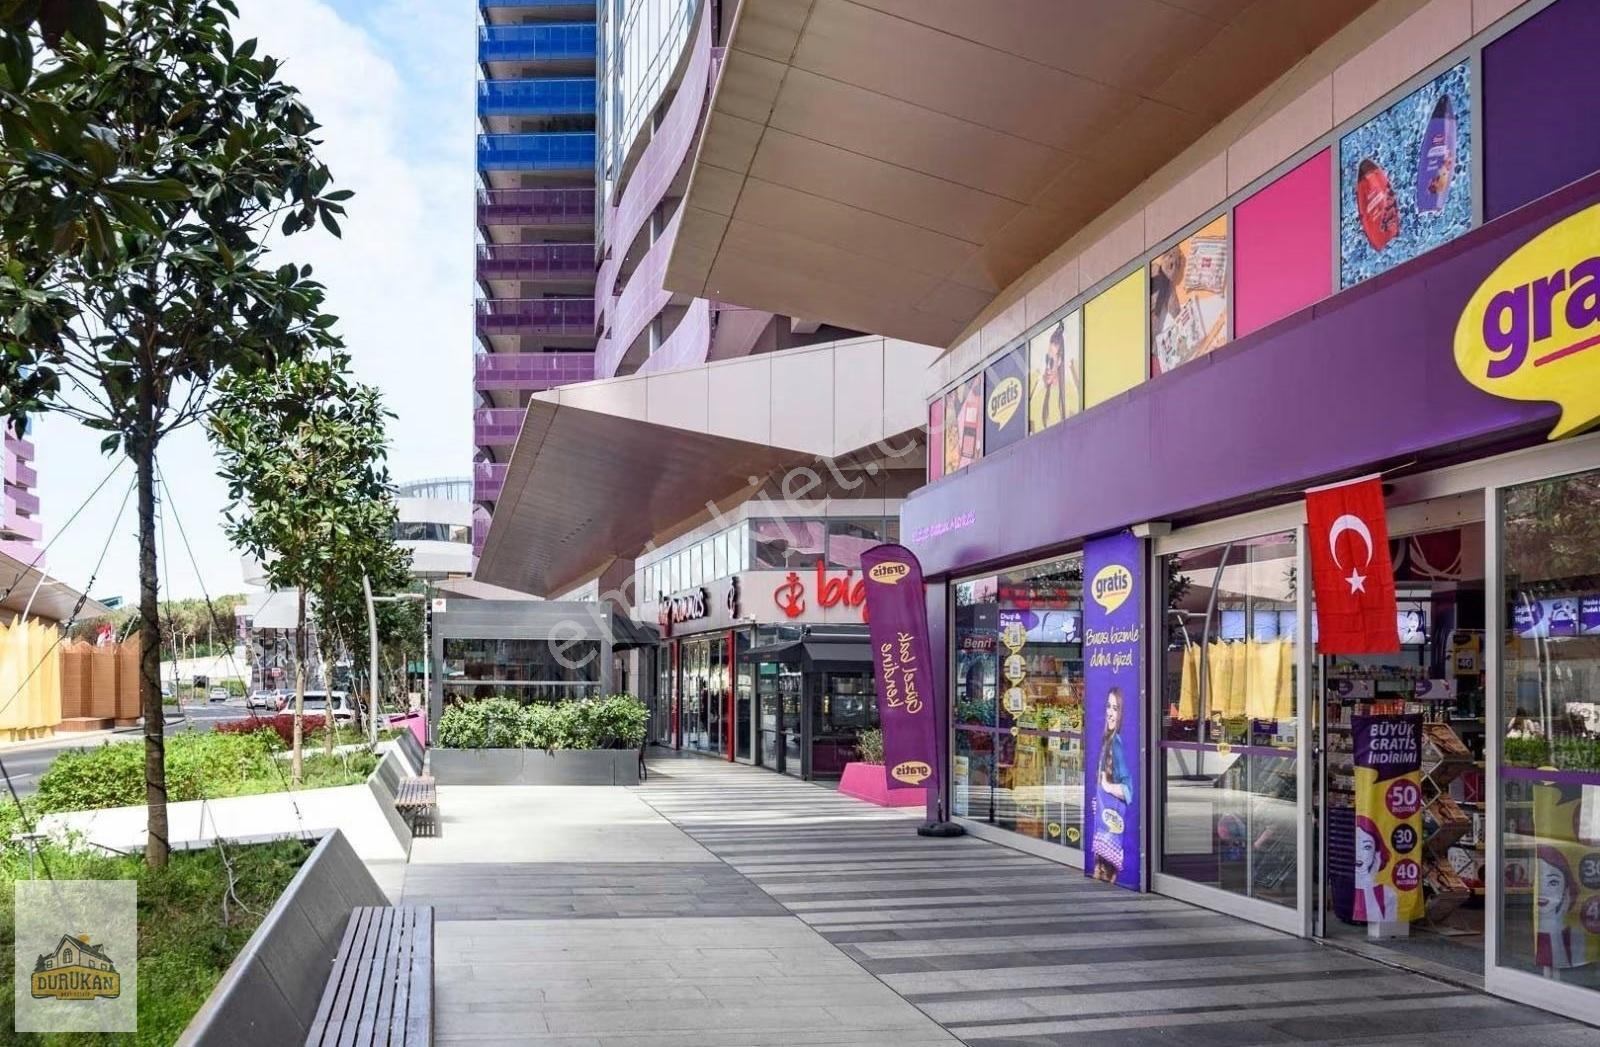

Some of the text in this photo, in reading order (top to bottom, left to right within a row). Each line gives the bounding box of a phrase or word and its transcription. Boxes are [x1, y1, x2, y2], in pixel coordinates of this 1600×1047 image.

[1482, 256, 1600, 379] gra
[991, 380, 1018, 417] gratis
[1096, 569, 1128, 599] gratis
[1370, 721, 1415, 736] BÜYÜK
[1370, 735, 1417, 750] GRATİS
[1368, 750, 1417, 764] İNDİRİMİ
